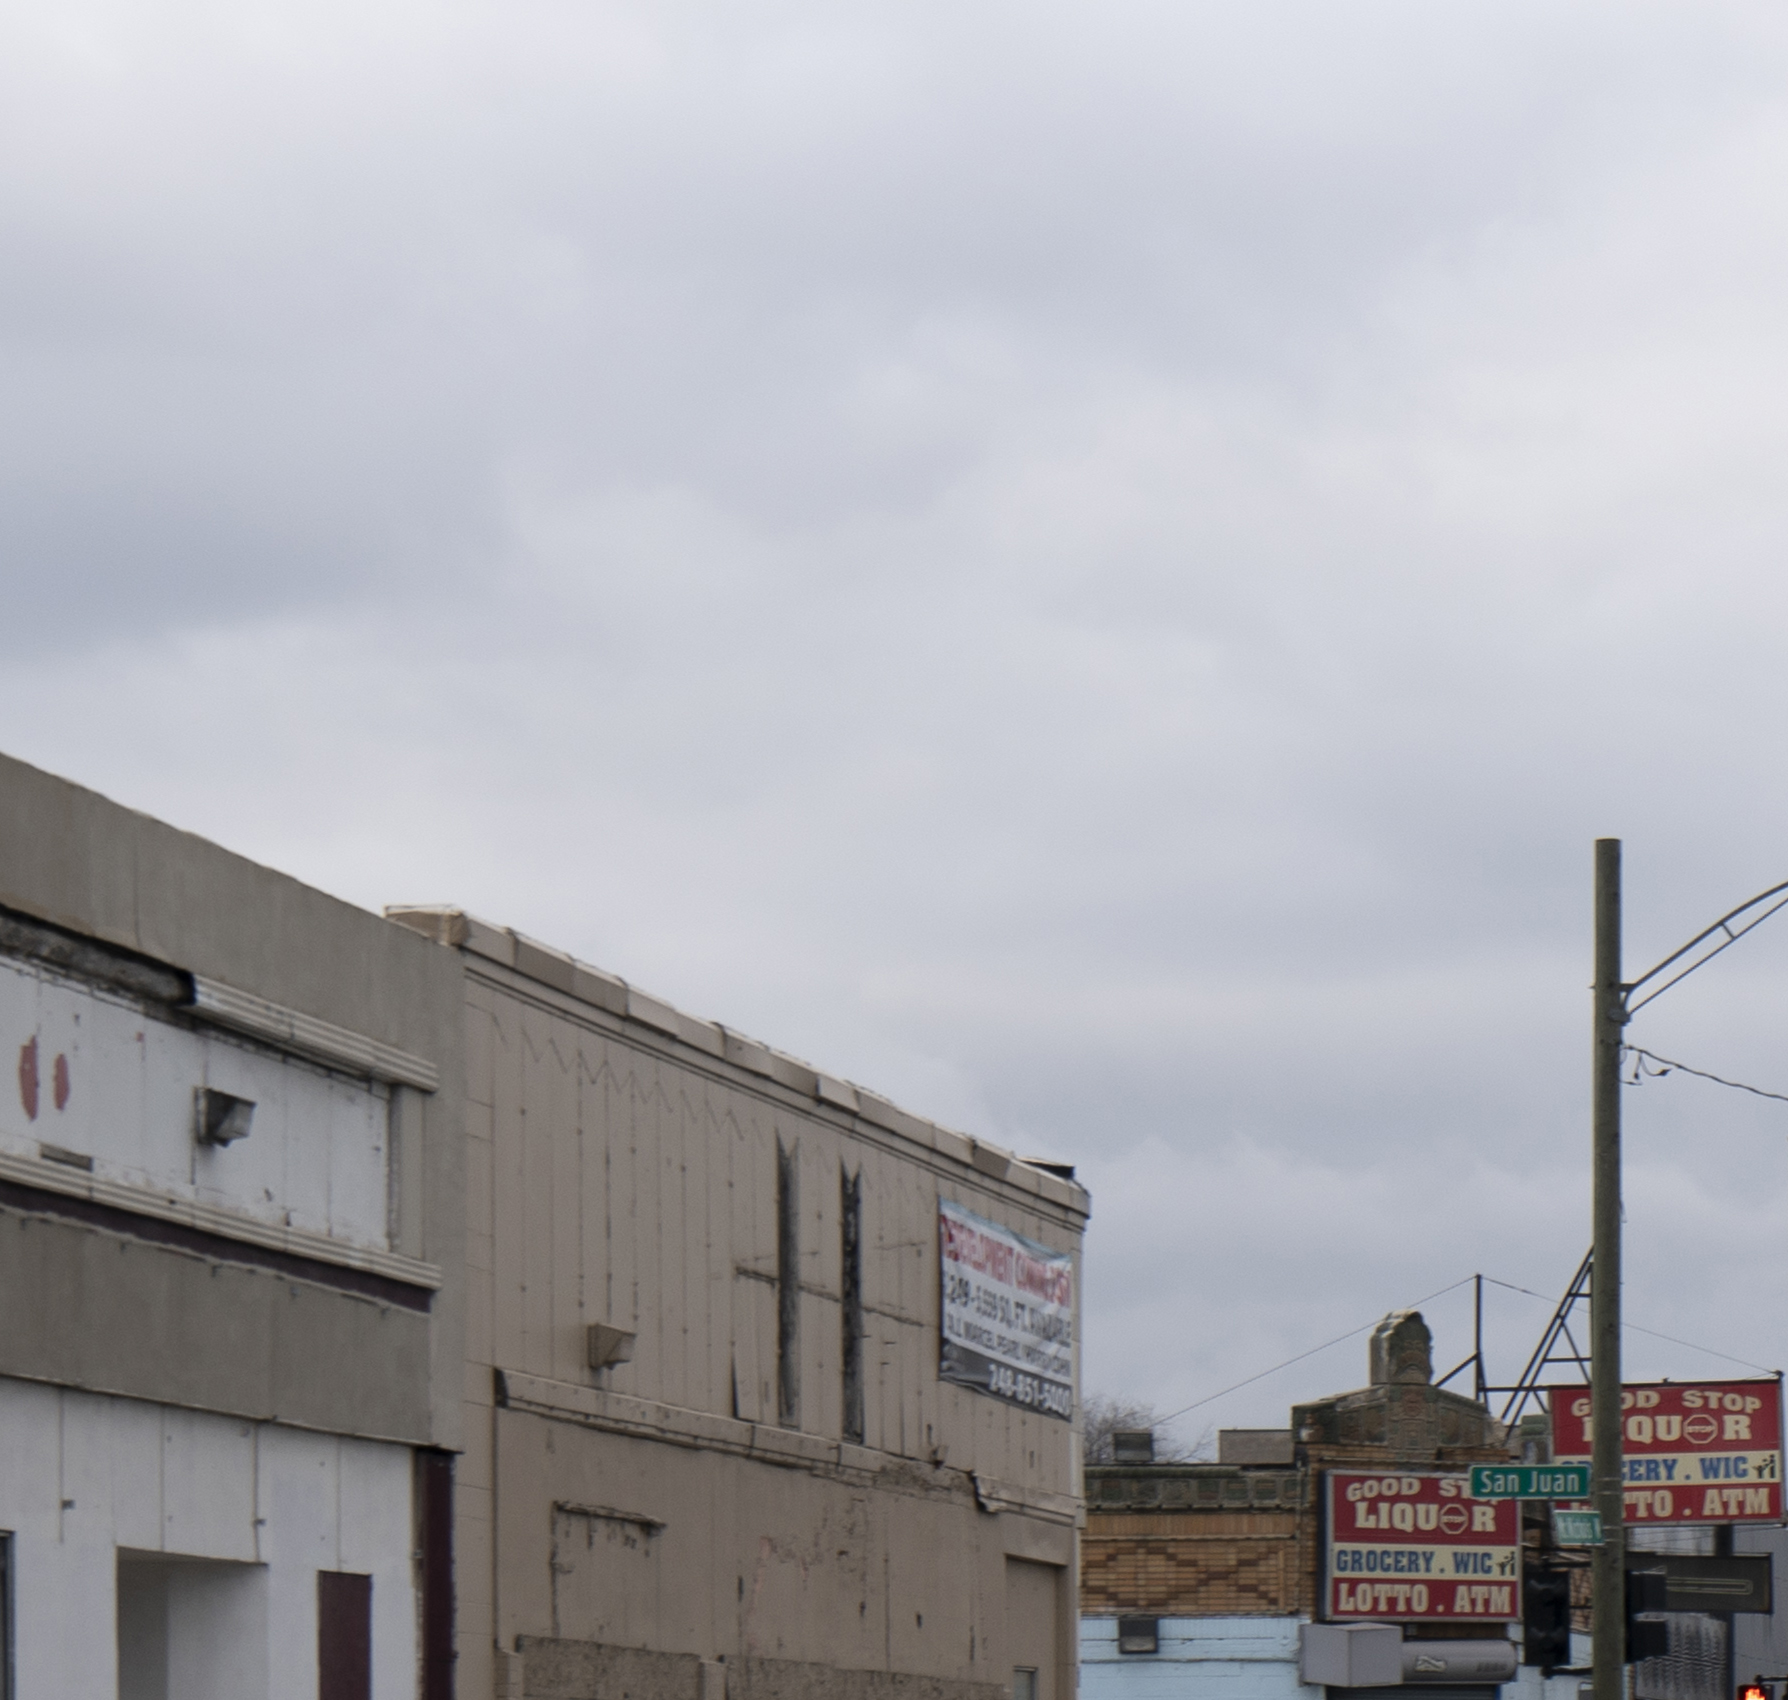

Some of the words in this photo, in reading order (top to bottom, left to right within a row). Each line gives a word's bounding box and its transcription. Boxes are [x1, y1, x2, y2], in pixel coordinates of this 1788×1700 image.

[1681, 1390, 1762, 1414] STOP
[1700, 1456, 1749, 1480] WIC
[1346, 1478, 1422, 1501] GOOD
[1480, 1470, 1519, 1493] San
[1528, 1470, 1579, 1493] Juan
[1702, 1487, 1770, 1516] ATM
[1336, 1550, 1435, 1573] GROCERY
[1453, 1552, 1493, 1574] WIC
[1338, 1583, 1429, 1613] LOTTO
[1453, 1585, 1511, 1613] ATM
